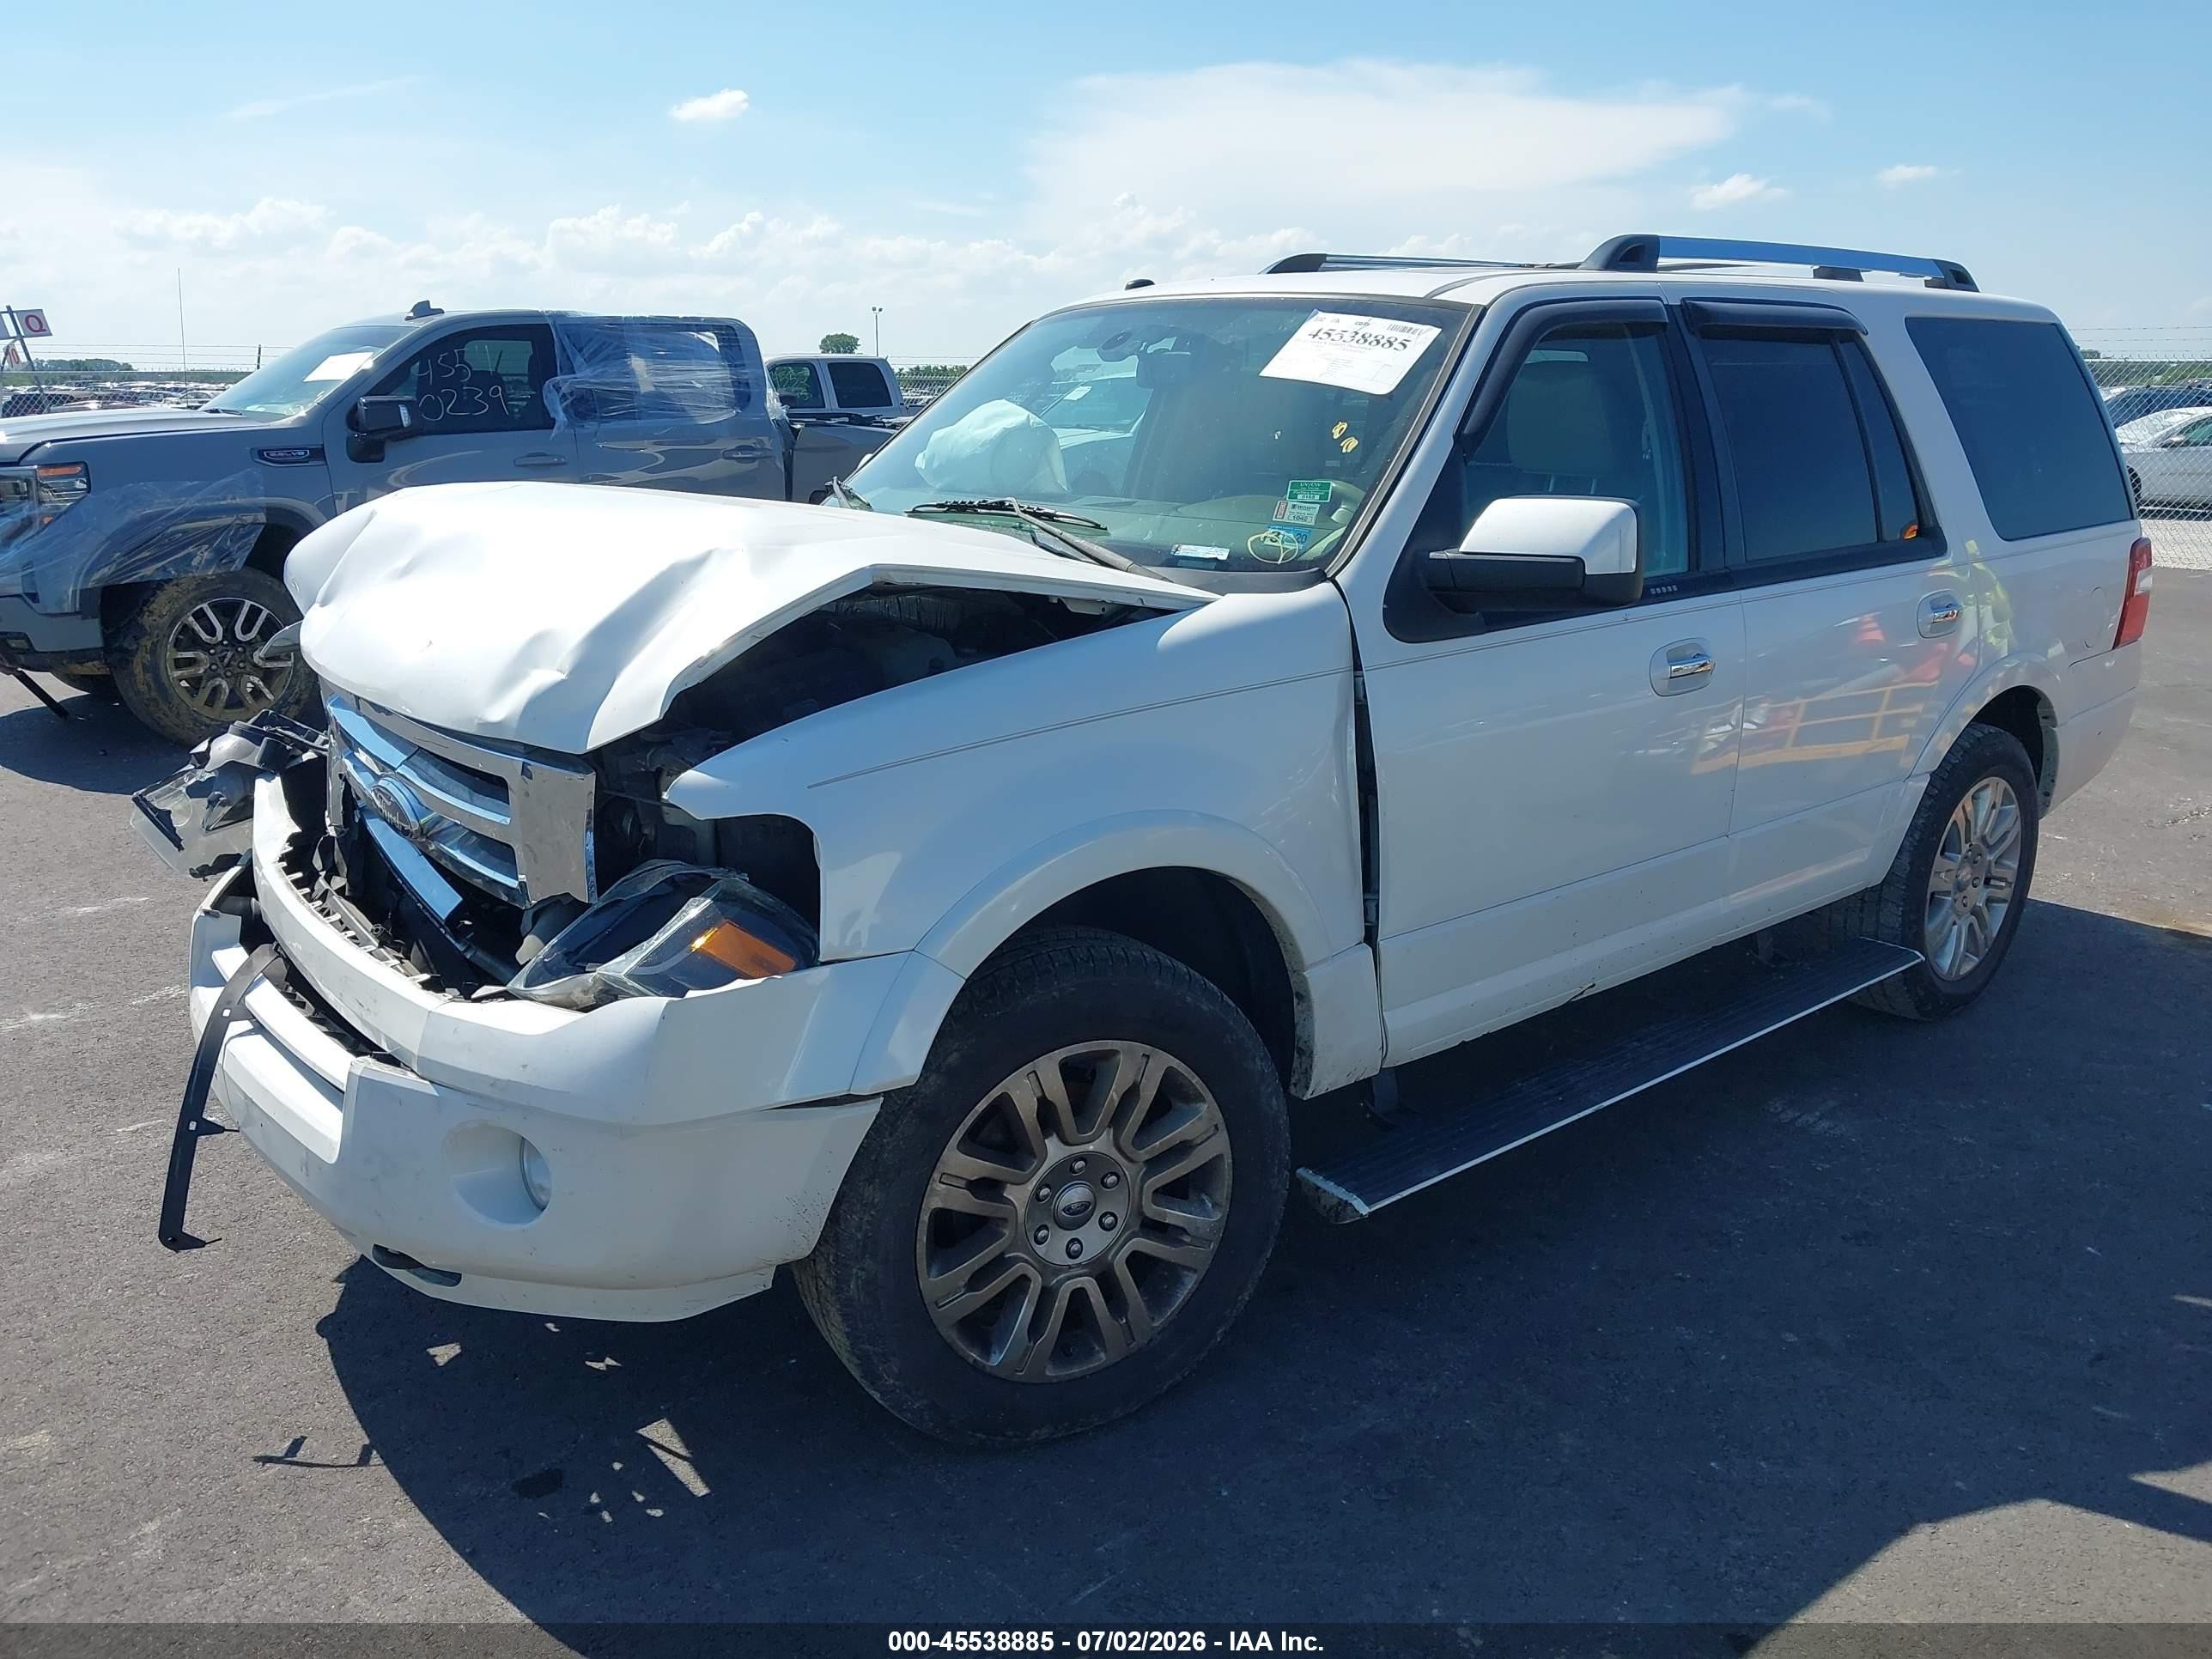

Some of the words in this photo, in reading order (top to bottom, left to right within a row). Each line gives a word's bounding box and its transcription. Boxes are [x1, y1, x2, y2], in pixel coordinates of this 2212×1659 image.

[24, 314, 47, 333] Q
[1308, 326, 1413, 352] 45538885
[418, 385, 509, 422] 0239
